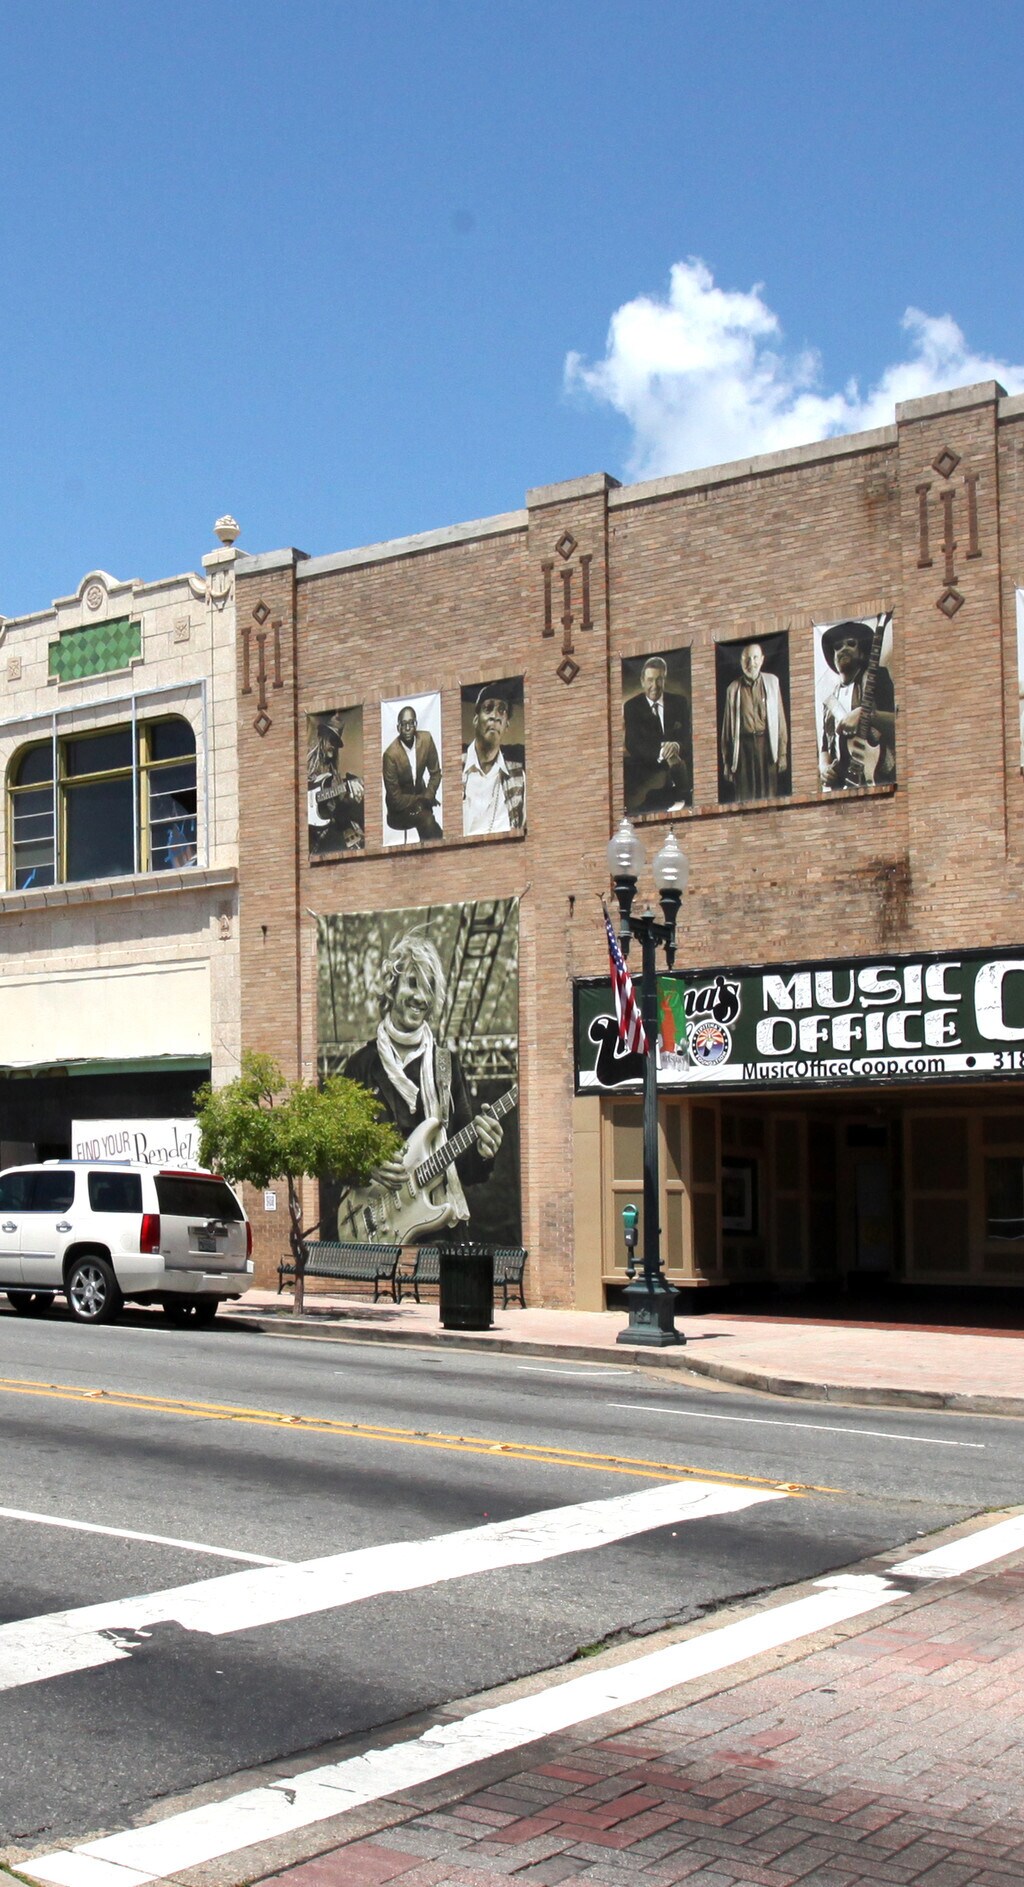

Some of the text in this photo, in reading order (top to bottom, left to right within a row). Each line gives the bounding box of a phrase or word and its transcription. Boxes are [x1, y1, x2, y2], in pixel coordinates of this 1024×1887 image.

[763, 962, 962, 1012] MUSIC
[756, 1008, 962, 1056] OFFICE
[742, 1057, 946, 1080] MusicOfficeCoop.com
[76, 1139, 101, 1160] FIND
[101, 1131, 131, 1156] YOUR
